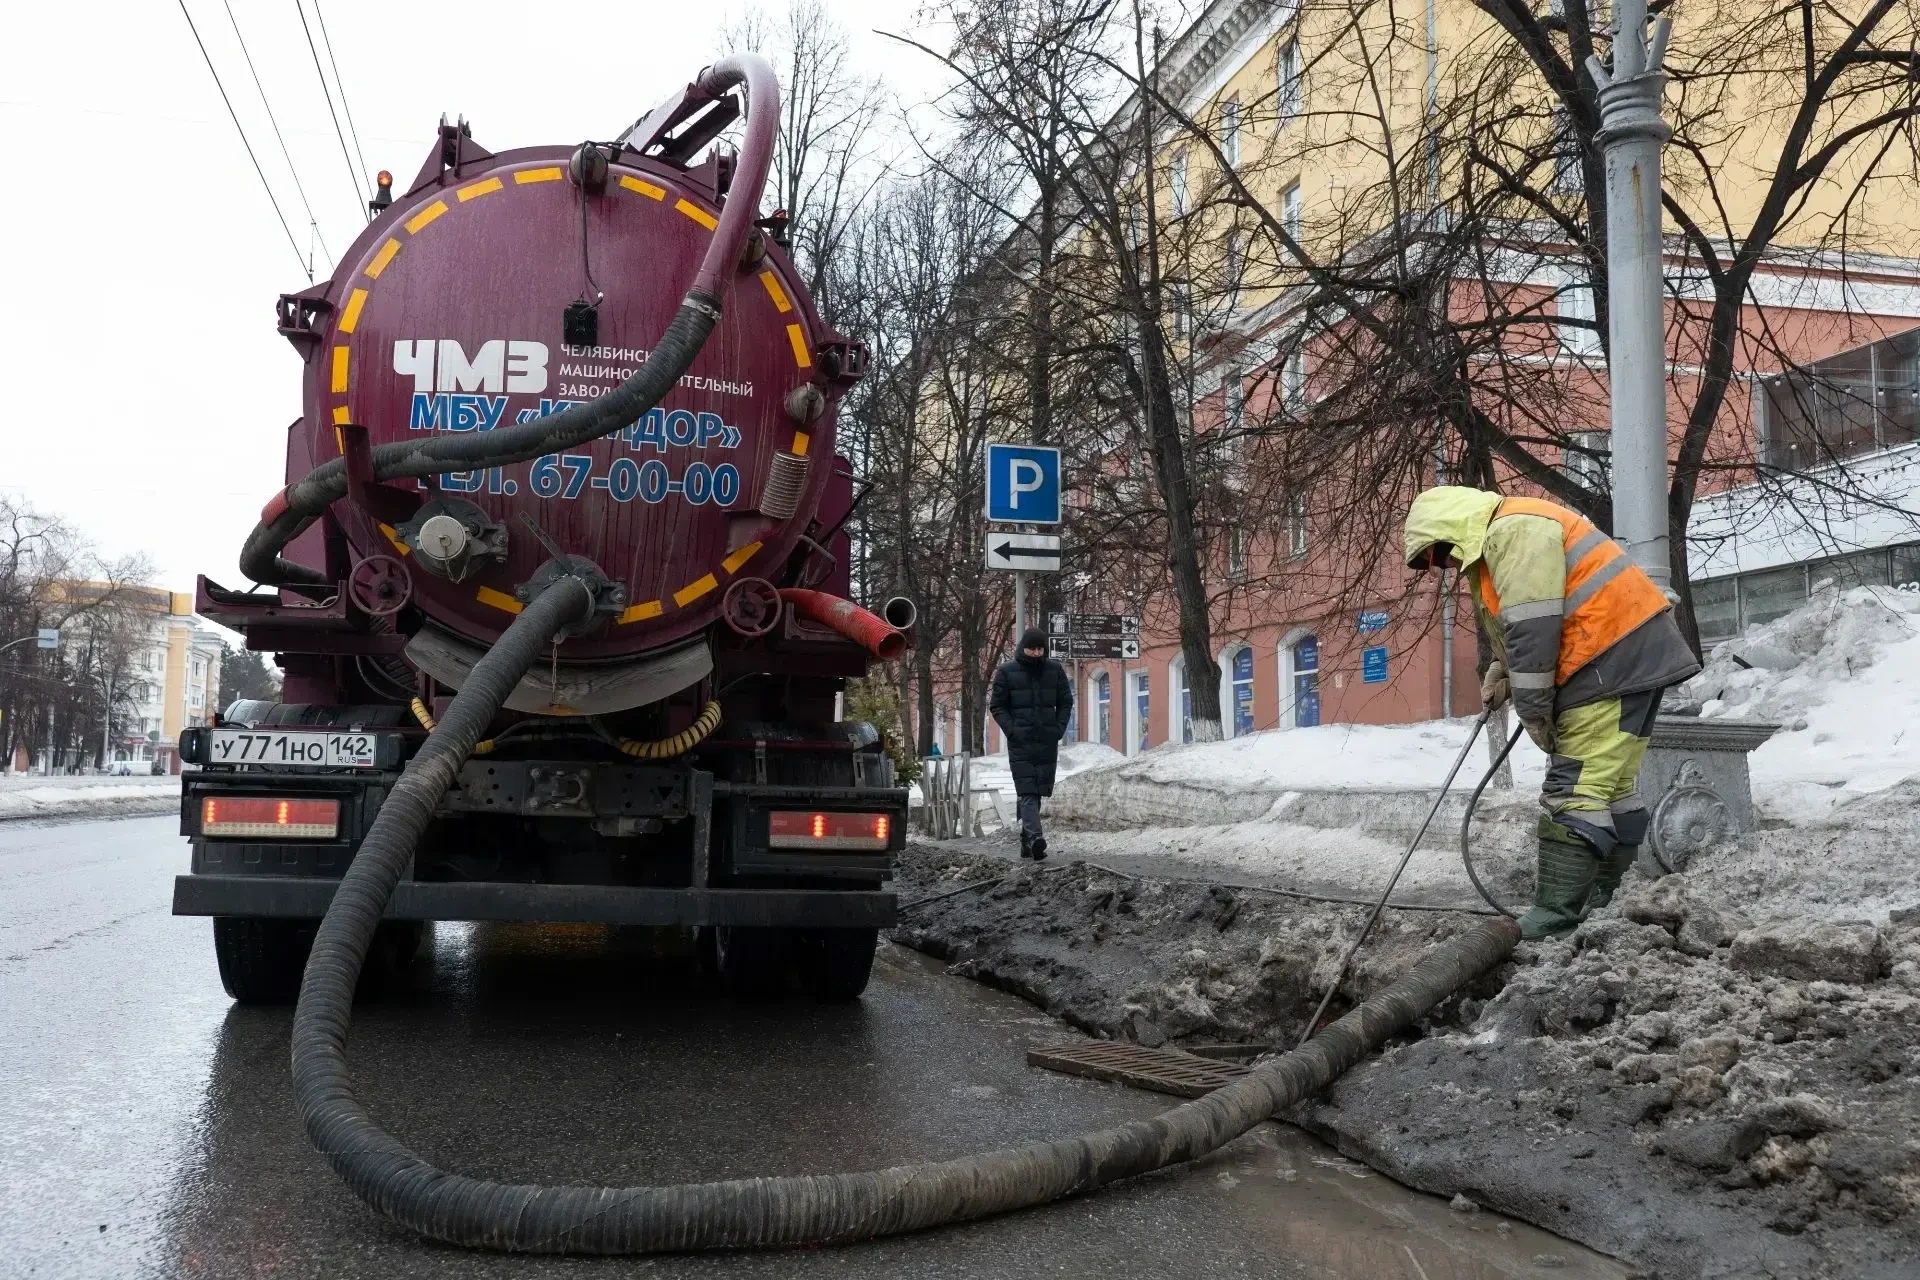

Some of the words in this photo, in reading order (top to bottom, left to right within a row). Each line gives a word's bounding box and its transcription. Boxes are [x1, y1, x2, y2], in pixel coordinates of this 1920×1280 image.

[393, 339, 548, 394] ЧМЗ
[410, 392, 508, 432] МБУ
[529, 453, 740, 507] 67-00-00
[1009, 458, 1044, 510] P
[330, 736, 368, 756] 142
[337, 756, 357, 764] RUS
